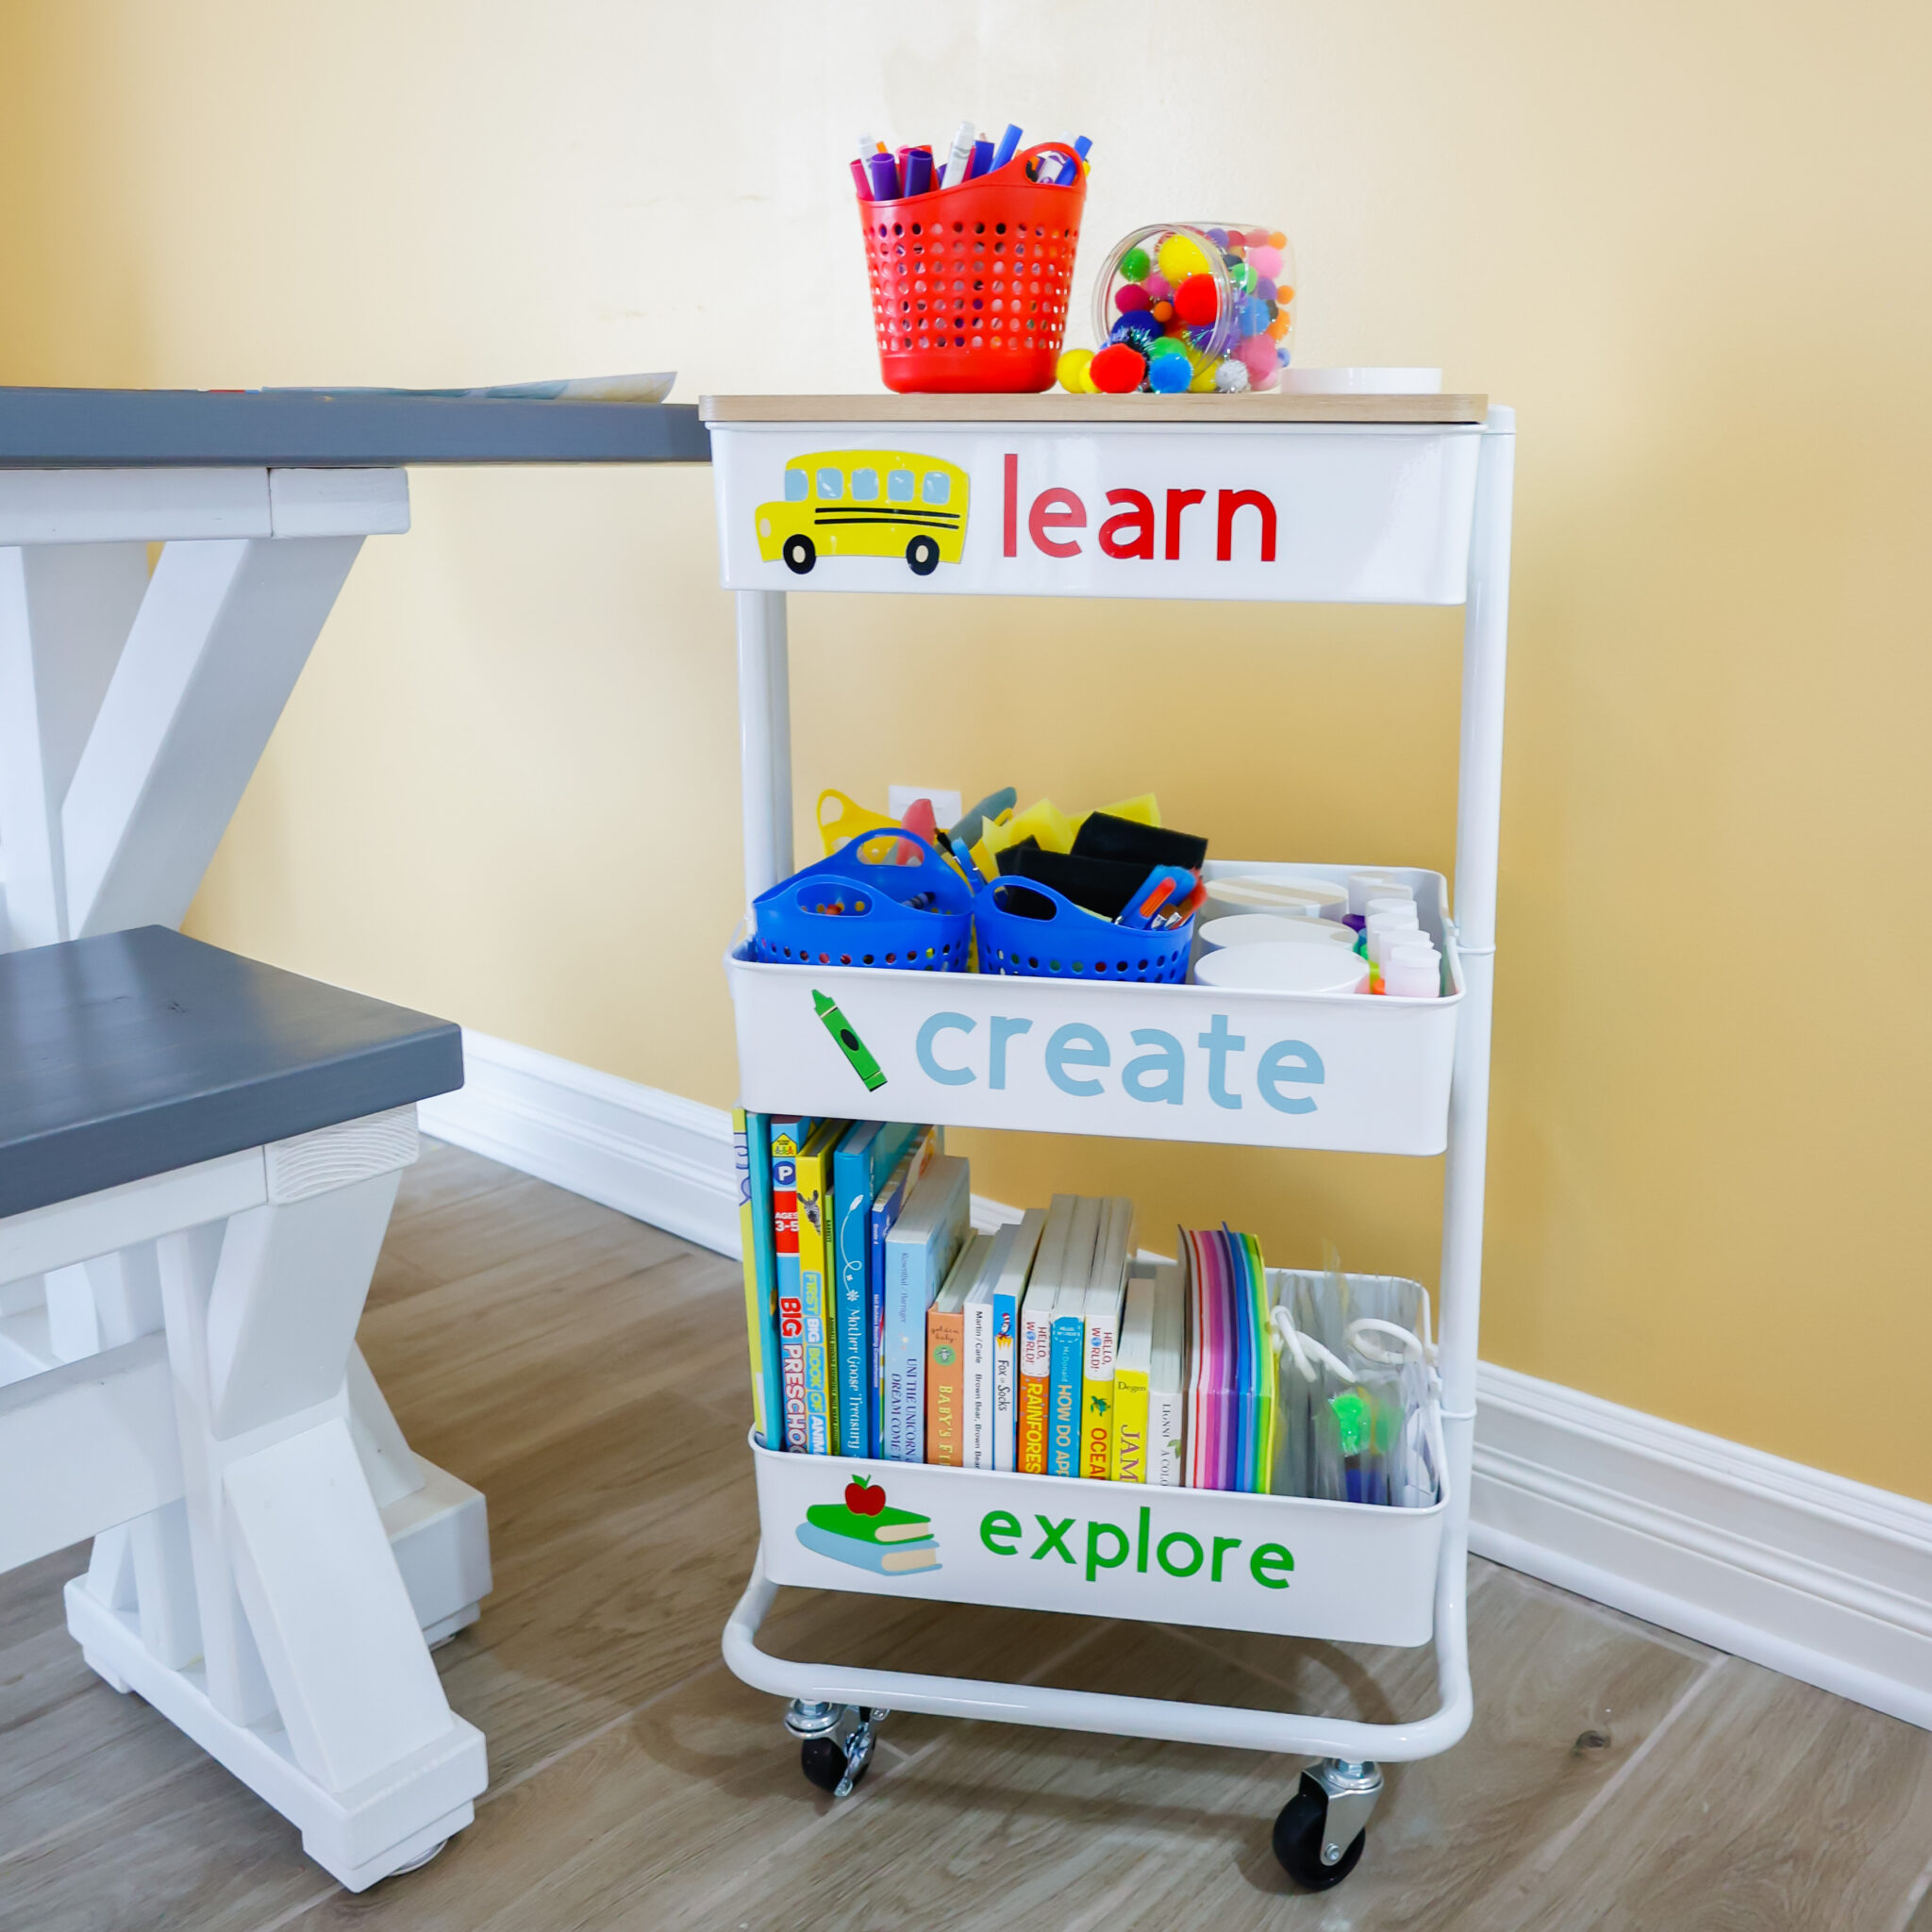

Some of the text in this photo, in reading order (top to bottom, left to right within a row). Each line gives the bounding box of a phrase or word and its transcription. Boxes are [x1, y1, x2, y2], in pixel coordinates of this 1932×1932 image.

[1003, 453, 1277, 562] learn
[915, 1011, 1325, 1115] create
[778, 1166, 793, 1181] P
[774, 1211, 798, 1220] AGES
[775, 1221, 799, 1232] 3-5
[781, 1297, 803, 1338] BIG
[1036, 1326, 1047, 1359] HELLO,
[1102, 1331, 1113, 1365] HELLO,
[805, 1274, 825, 1455] FIRST BIG BOOK OF ANIM
[845, 1307, 863, 1449] Mother Goose Treasury
[907, 1358, 918, 1377] UNI
[997, 1359, 1009, 1375] Fox
[891, 1374, 902, 1415] DREAM
[906, 1380, 917, 1401] THE
[997, 1384, 1010, 1411] Socks
[1057, 1385, 1072, 1421] HOW
[974, 1401, 982, 1422] Bear,
[1161, 1404, 1171, 1438] LIONNI
[891, 1417, 901, 1451] COME
[905, 1406, 917, 1456] UNICORN
[1056, 1424, 1071, 1446] DO
[979, 1506, 1295, 1590] explore
